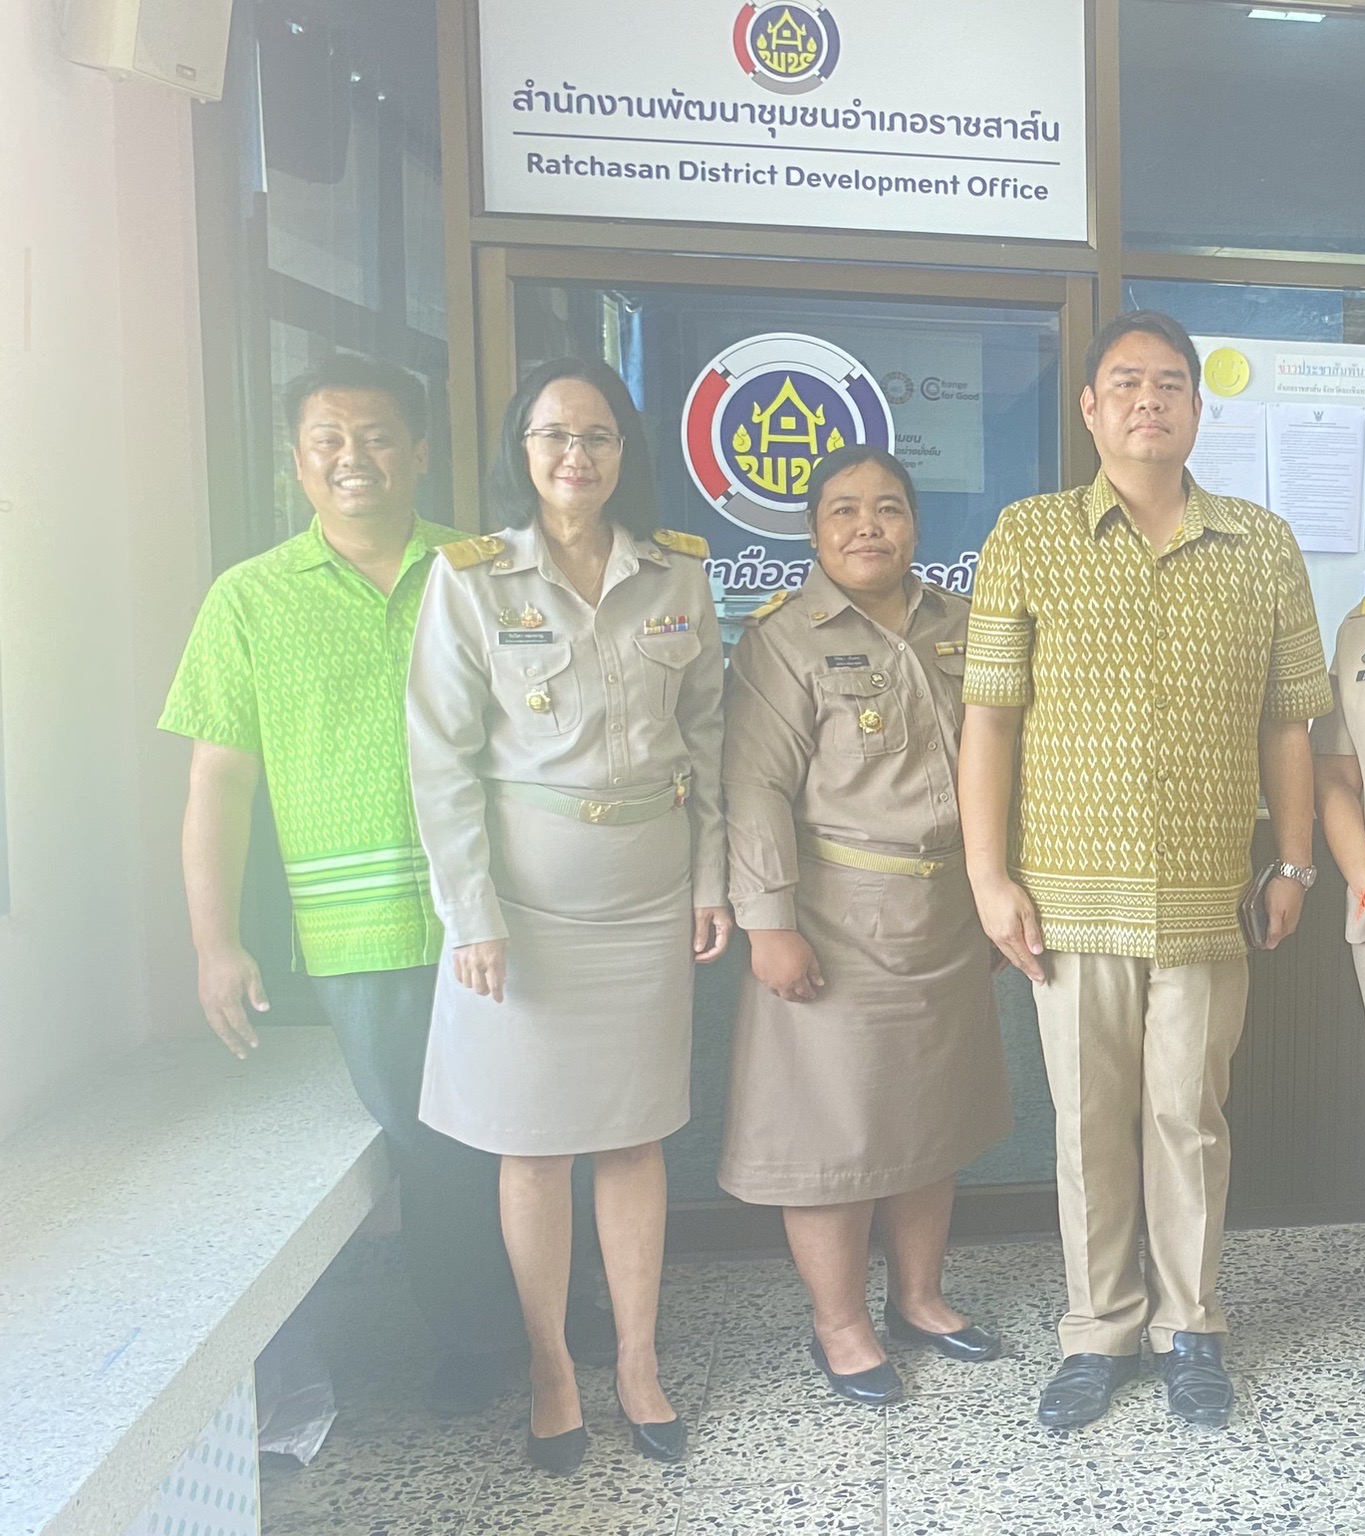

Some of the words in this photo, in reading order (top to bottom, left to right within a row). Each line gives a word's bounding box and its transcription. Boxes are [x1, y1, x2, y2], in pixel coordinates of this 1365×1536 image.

[512, 78, 1061, 142] สำนักงานพัฒนาชุมชนอำเภอราชสาส์น
[527, 152, 671, 181] Ratchasan
[678, 160, 779, 186] District
[785, 165, 961, 197] Development
[967, 175, 1049, 201] Office
[941, 391, 954, 400] for
[956, 392, 980, 401] Good
